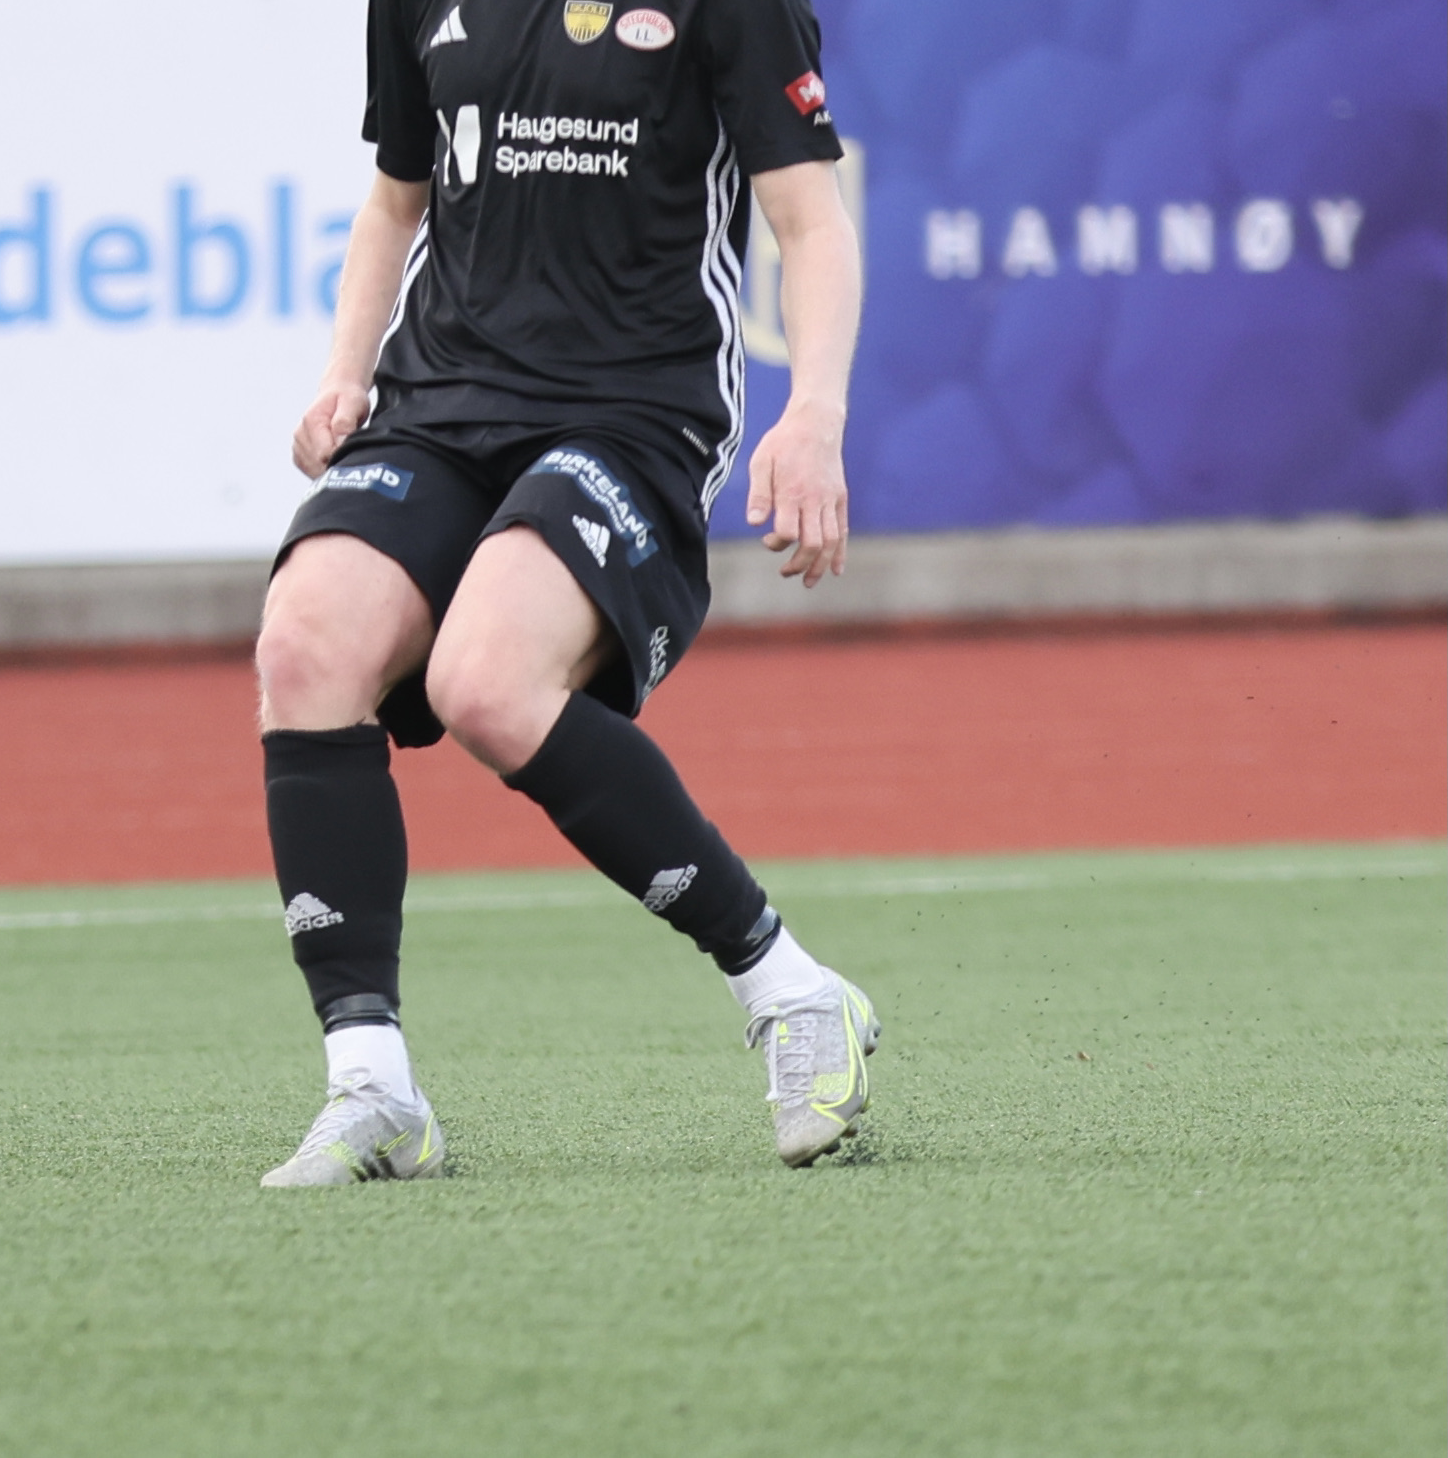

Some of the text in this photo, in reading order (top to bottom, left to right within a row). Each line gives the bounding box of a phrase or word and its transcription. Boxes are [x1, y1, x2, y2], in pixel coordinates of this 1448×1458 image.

[497, 111, 639, 146] Haugesund
[495, 145, 629, 179] Sparebank
[923, 198, 1365, 281] HAMNØY
[544, 450, 648, 550] BIRKELAND
